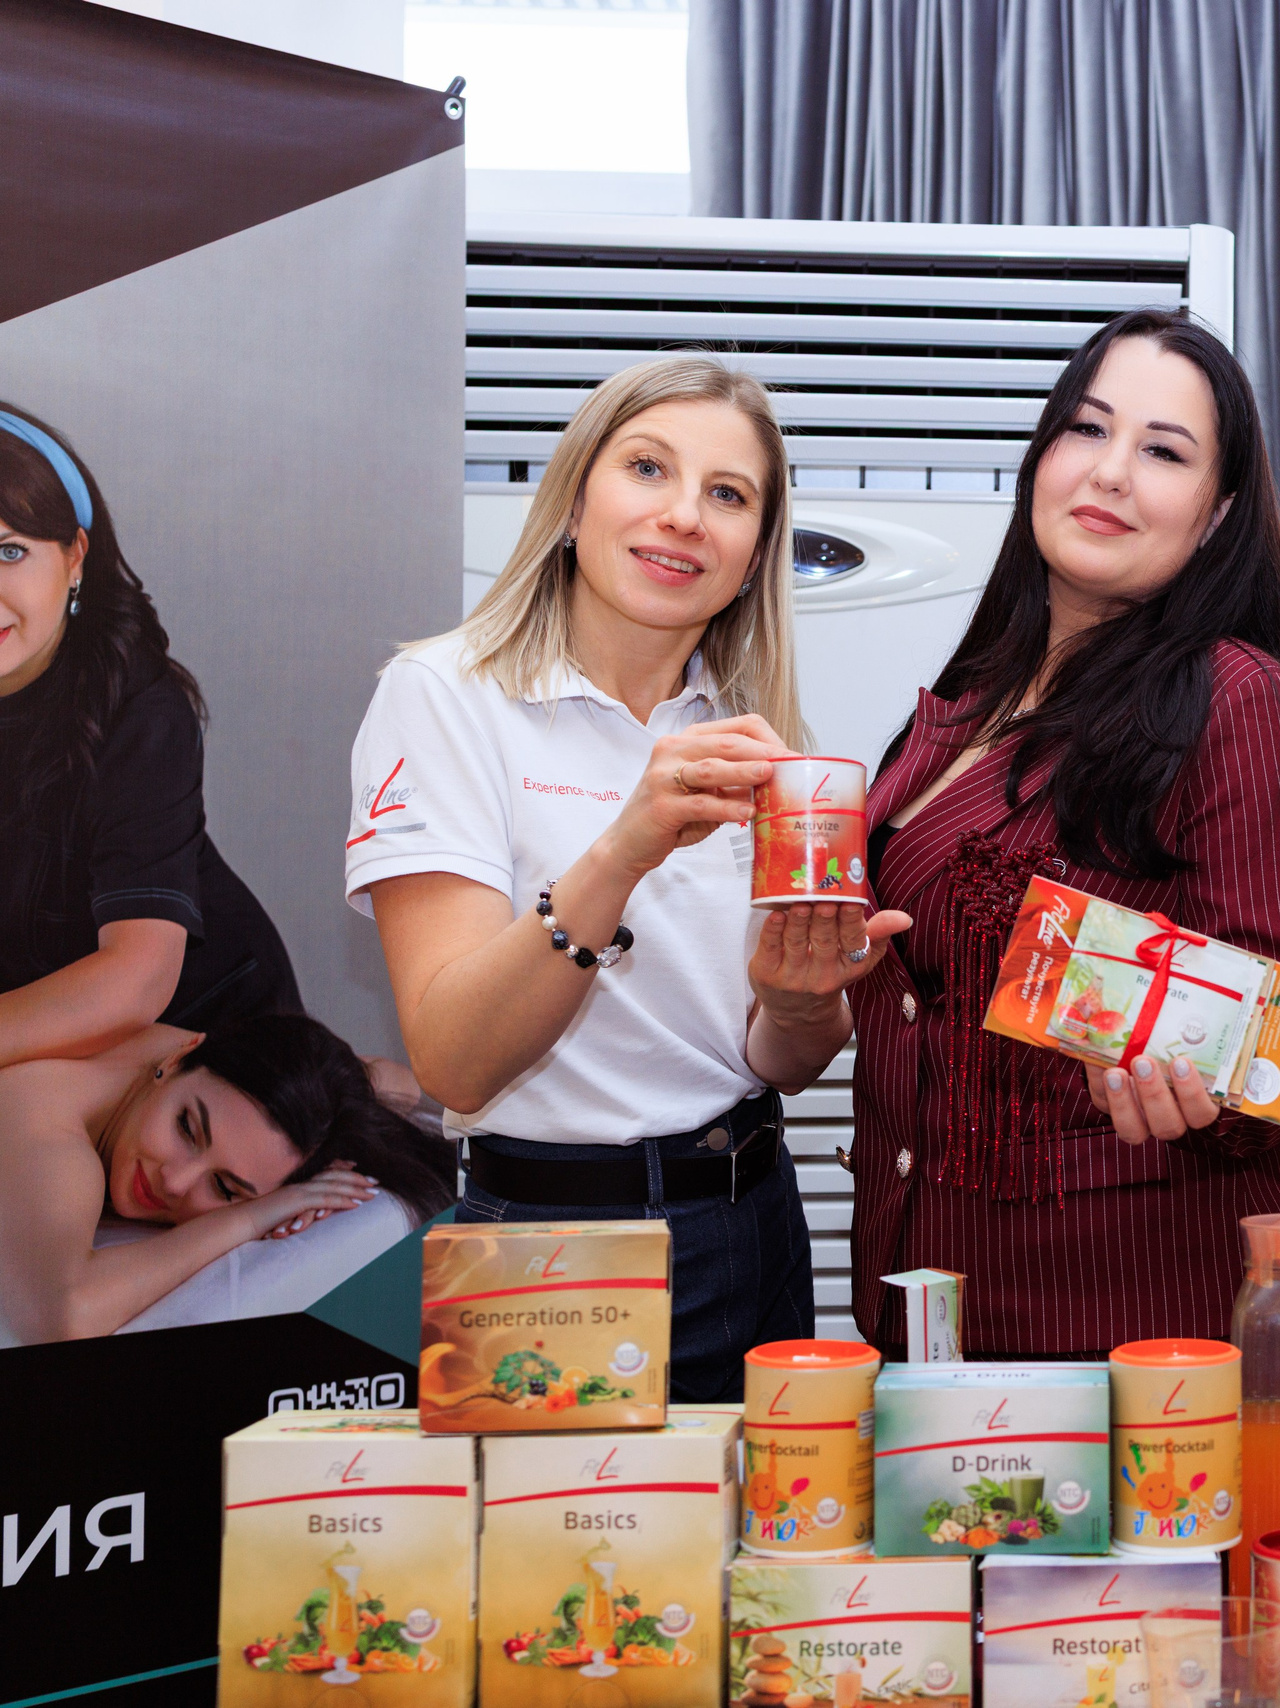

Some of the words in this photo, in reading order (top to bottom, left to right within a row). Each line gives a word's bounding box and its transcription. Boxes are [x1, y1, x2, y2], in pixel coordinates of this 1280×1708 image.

[523, 777, 584, 797] Experience
[586, 789, 624, 802] results.
[793, 820, 840, 832] Activize
[1021, 951, 1041, 1000] результат
[1026, 955, 1054, 1024] Почувствуйте
[1136, 974, 1189, 1001] Rerate
[459, 1308, 583, 1328] Generation
[591, 1306, 632, 1323] 50+
[1128, 1438, 1215, 1455] PowerCocktail
[952, 1454, 1032, 1473] D-Drink
[308, 1513, 383, 1533] Basics
[564, 1510, 638, 1530] Basics
[799, 1638, 903, 1657] Restorate
[1052, 1635, 1143, 1655] Restorat
